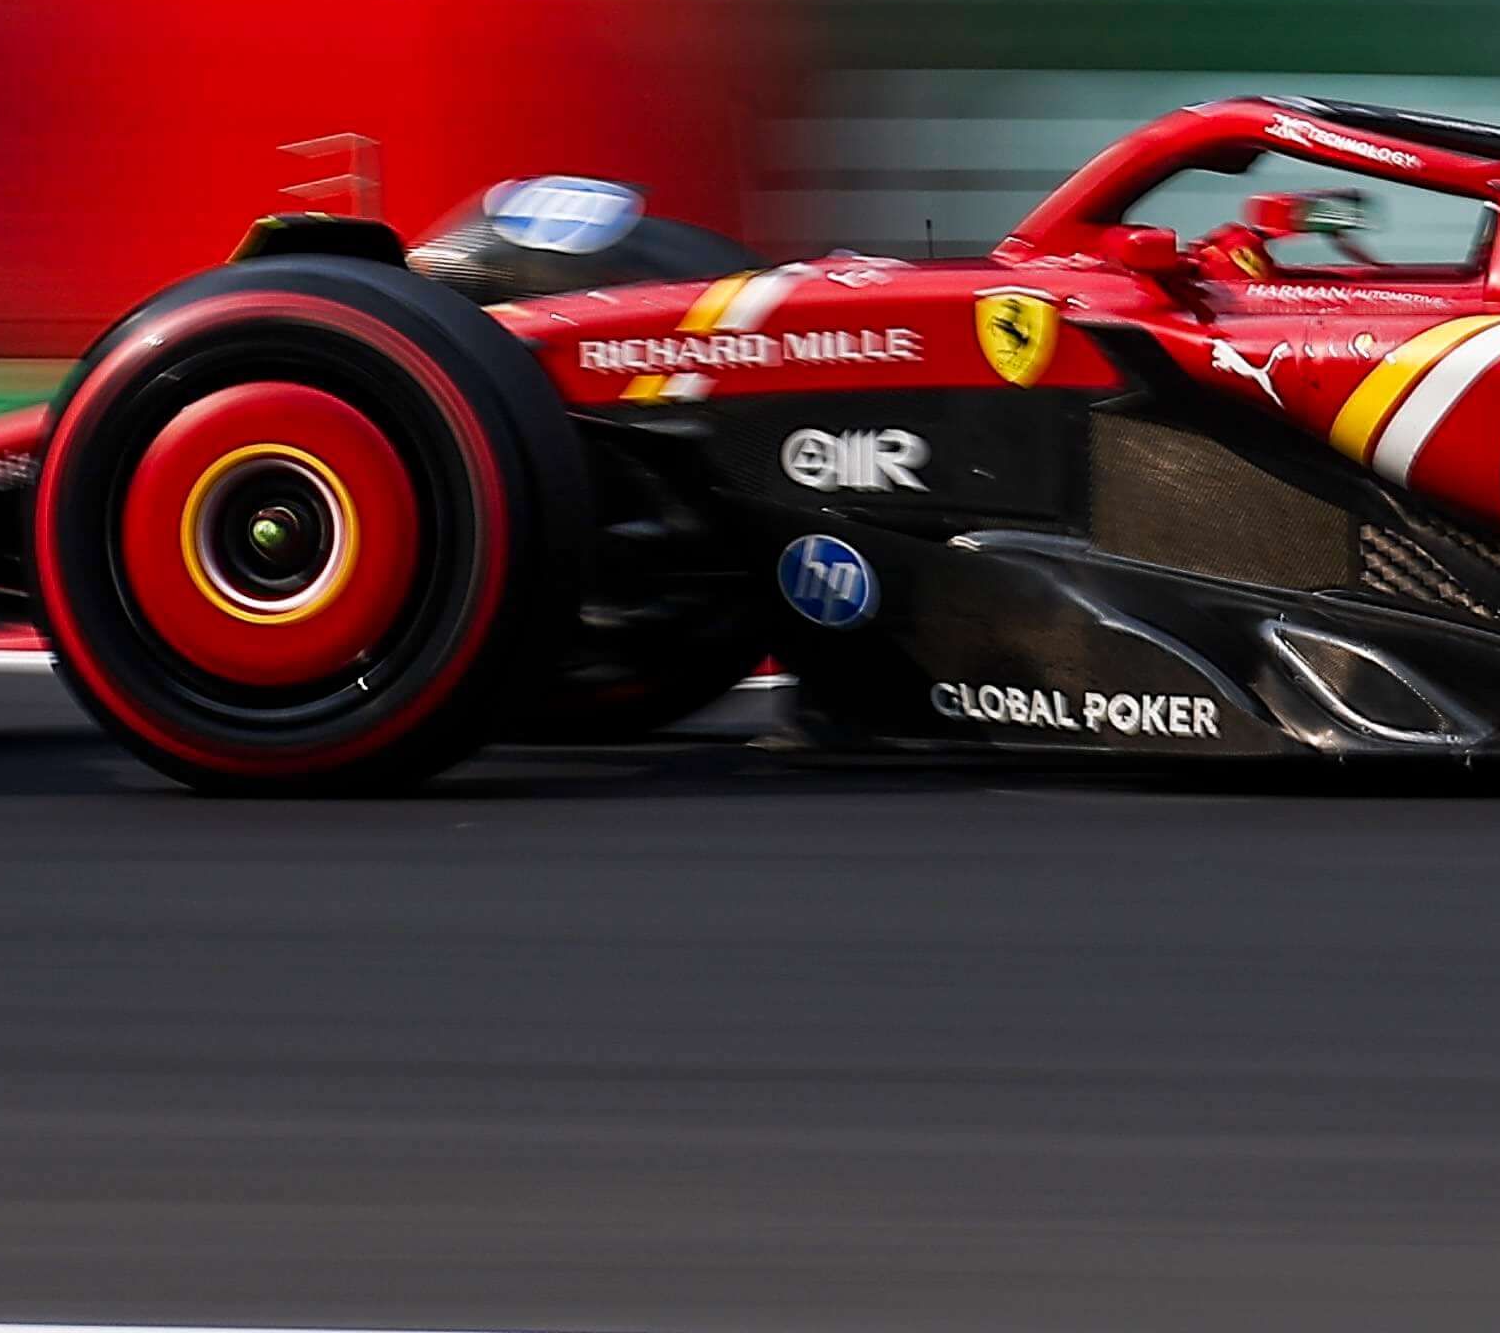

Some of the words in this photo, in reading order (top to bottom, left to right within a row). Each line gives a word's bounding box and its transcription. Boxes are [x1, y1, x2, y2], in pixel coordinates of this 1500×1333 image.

[1308, 128, 1423, 169] TECHNOLOGY
[1246, 284, 1350, 303] HARMAN
[1352, 288, 1450, 309] AUTOMOTIVE
[579, 334, 784, 373] RICHARD
[783, 328, 925, 363] MILLE
[930, 682, 1080, 731] GLOBAL
[1083, 691, 1220, 738] POKER
